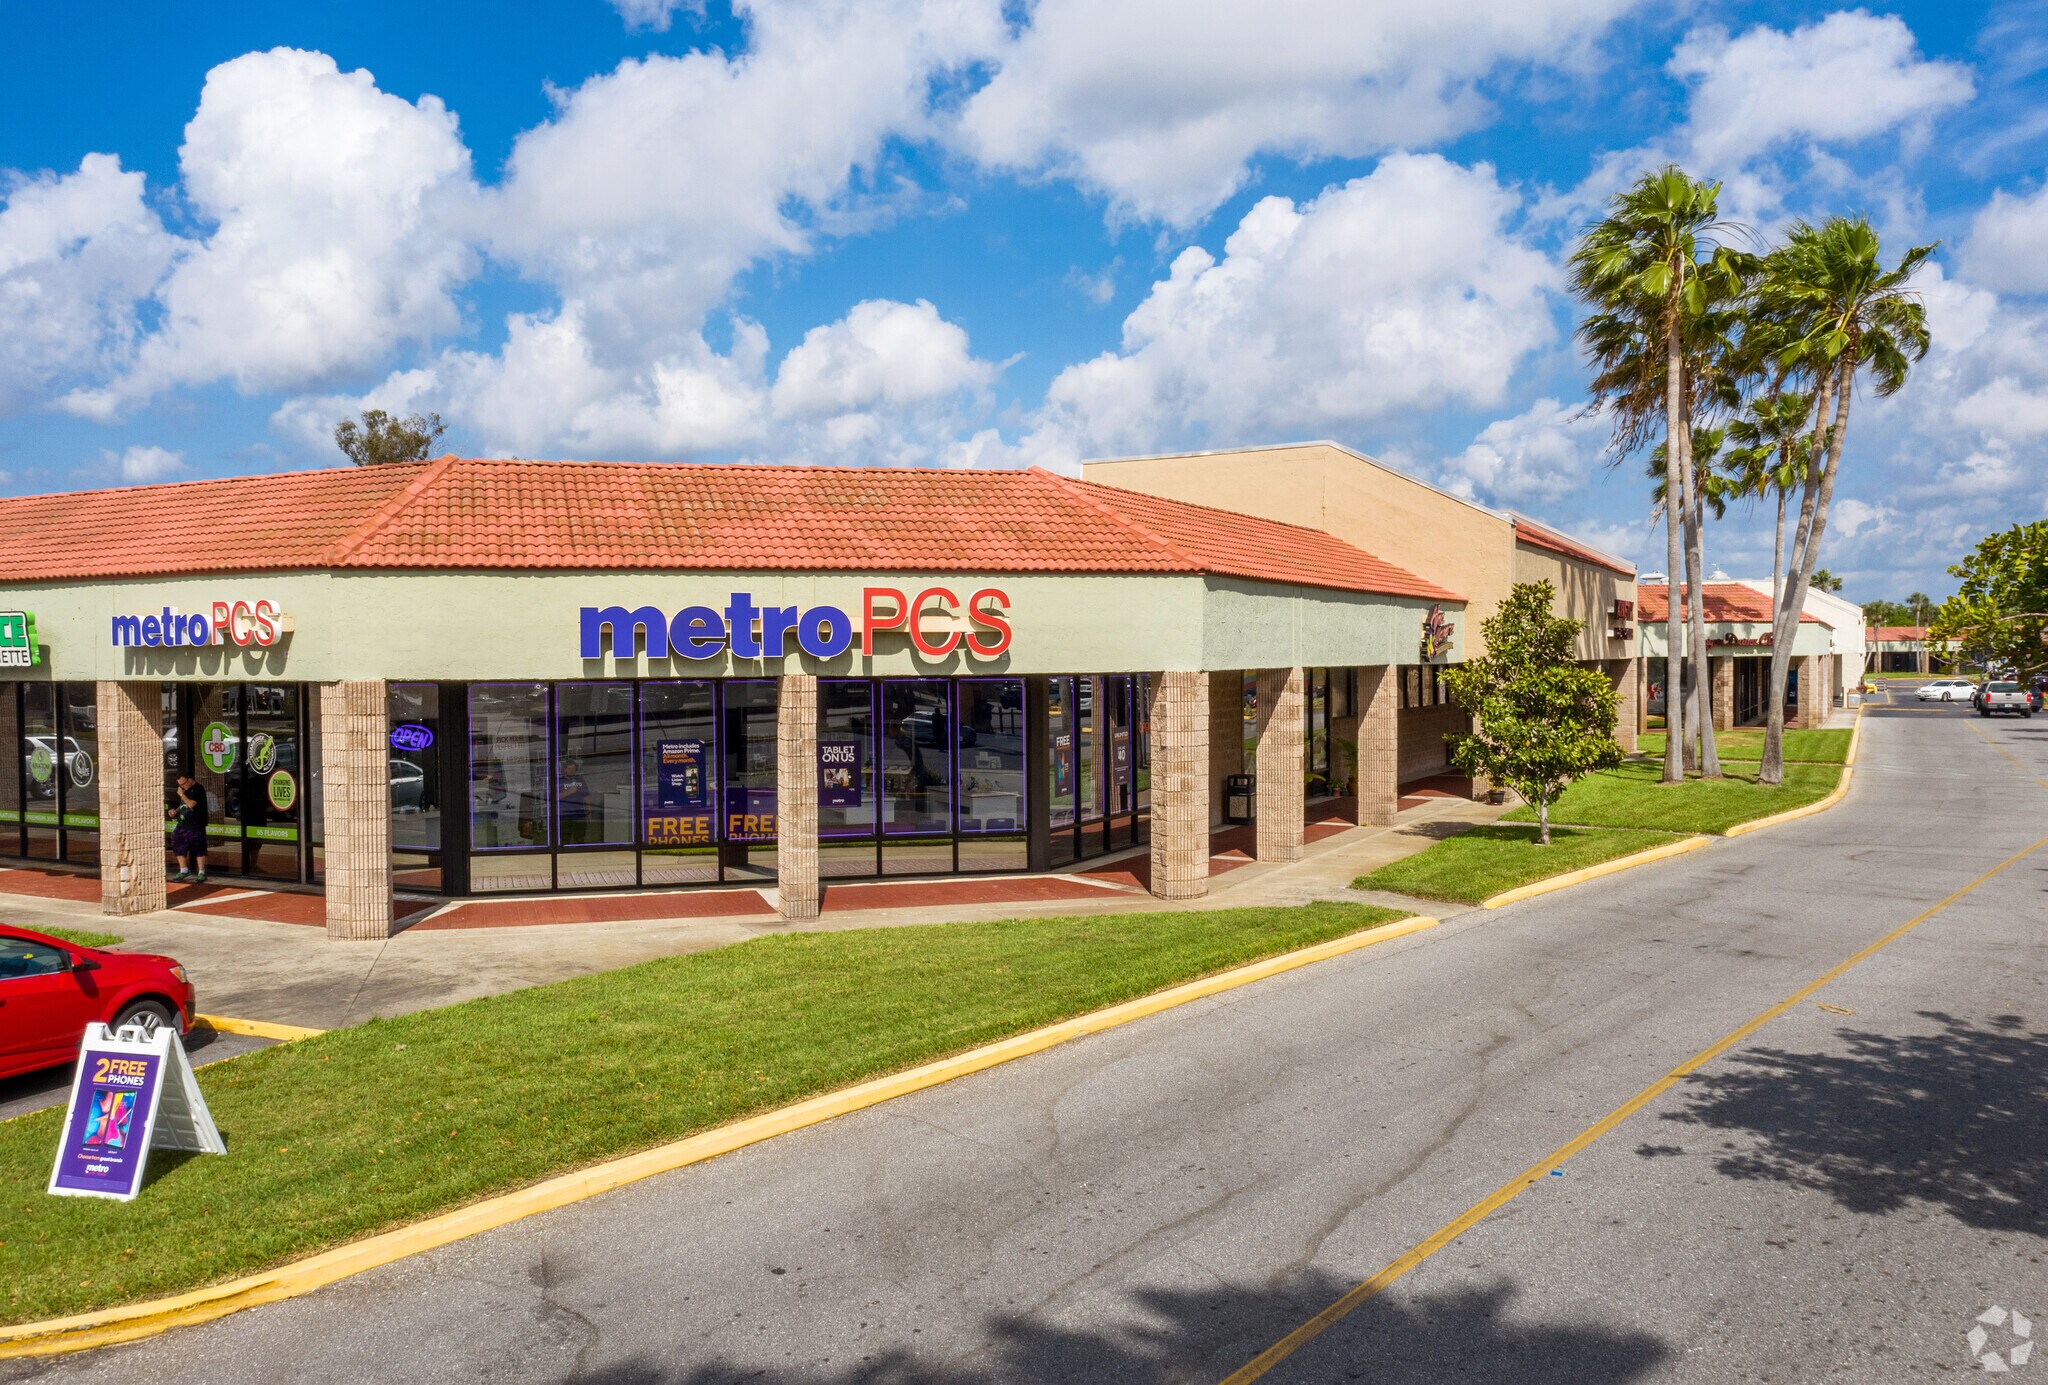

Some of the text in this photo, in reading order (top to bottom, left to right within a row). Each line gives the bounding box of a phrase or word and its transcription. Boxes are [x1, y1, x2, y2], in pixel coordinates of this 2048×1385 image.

[111, 599, 276, 647] metroPCS
[580, 587, 1013, 660] metroPCS
[0, 650, 29, 664] ETTE
[394, 727, 429, 749] OPEN
[1056, 734, 1071, 747] FREE
[208, 742, 226, 753] CBD
[822, 745, 855, 754] TABLET
[822, 753, 855, 763] ON US
[273, 786, 291, 798] LIVES
[648, 816, 710, 836] FREE
[728, 814, 778, 832] FRE
[256, 828, 289, 838] 85 FLAVORS
[92, 1057, 147, 1083] 2 FREE
[107, 1074, 145, 1086] PHONES
[85, 1163, 109, 1174] metro
